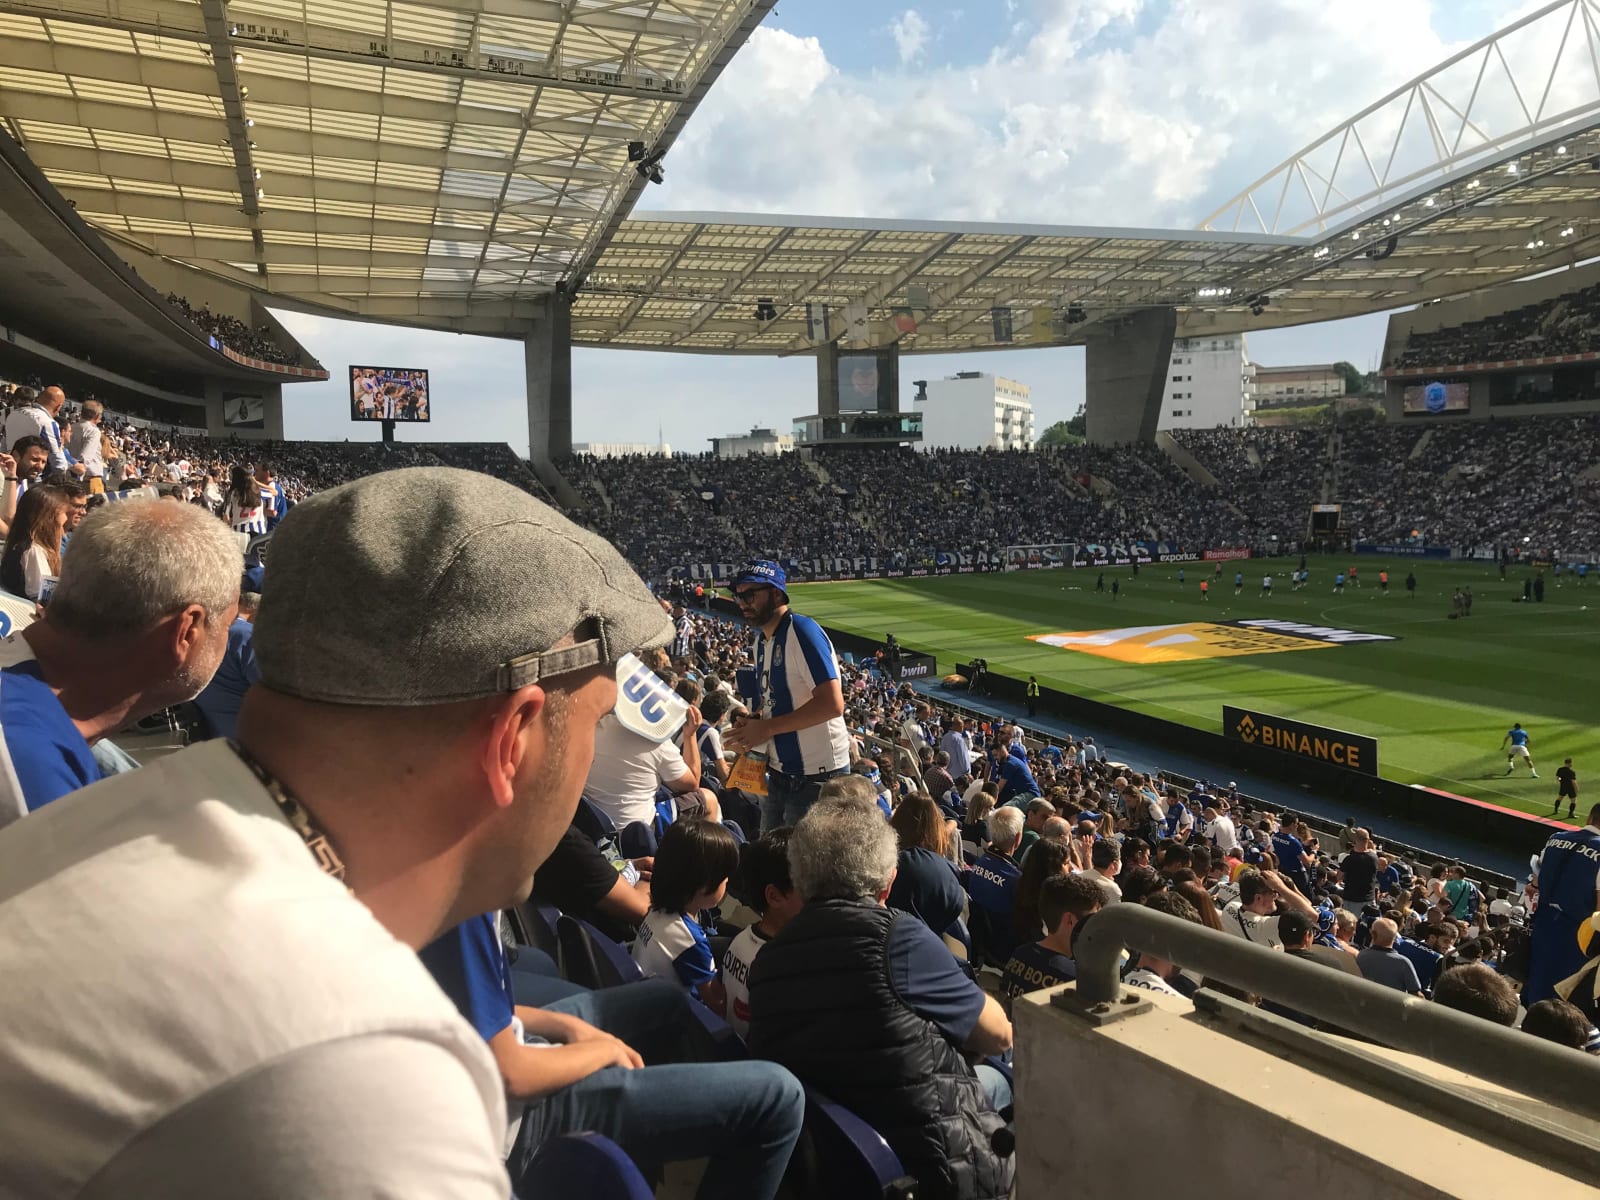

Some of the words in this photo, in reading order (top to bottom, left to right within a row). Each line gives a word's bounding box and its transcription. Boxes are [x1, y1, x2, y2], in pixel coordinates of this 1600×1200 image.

[901, 662, 927, 677] bwin
[1262, 725, 1360, 767] BINANCE
[984, 871, 1006, 887] BOCK
